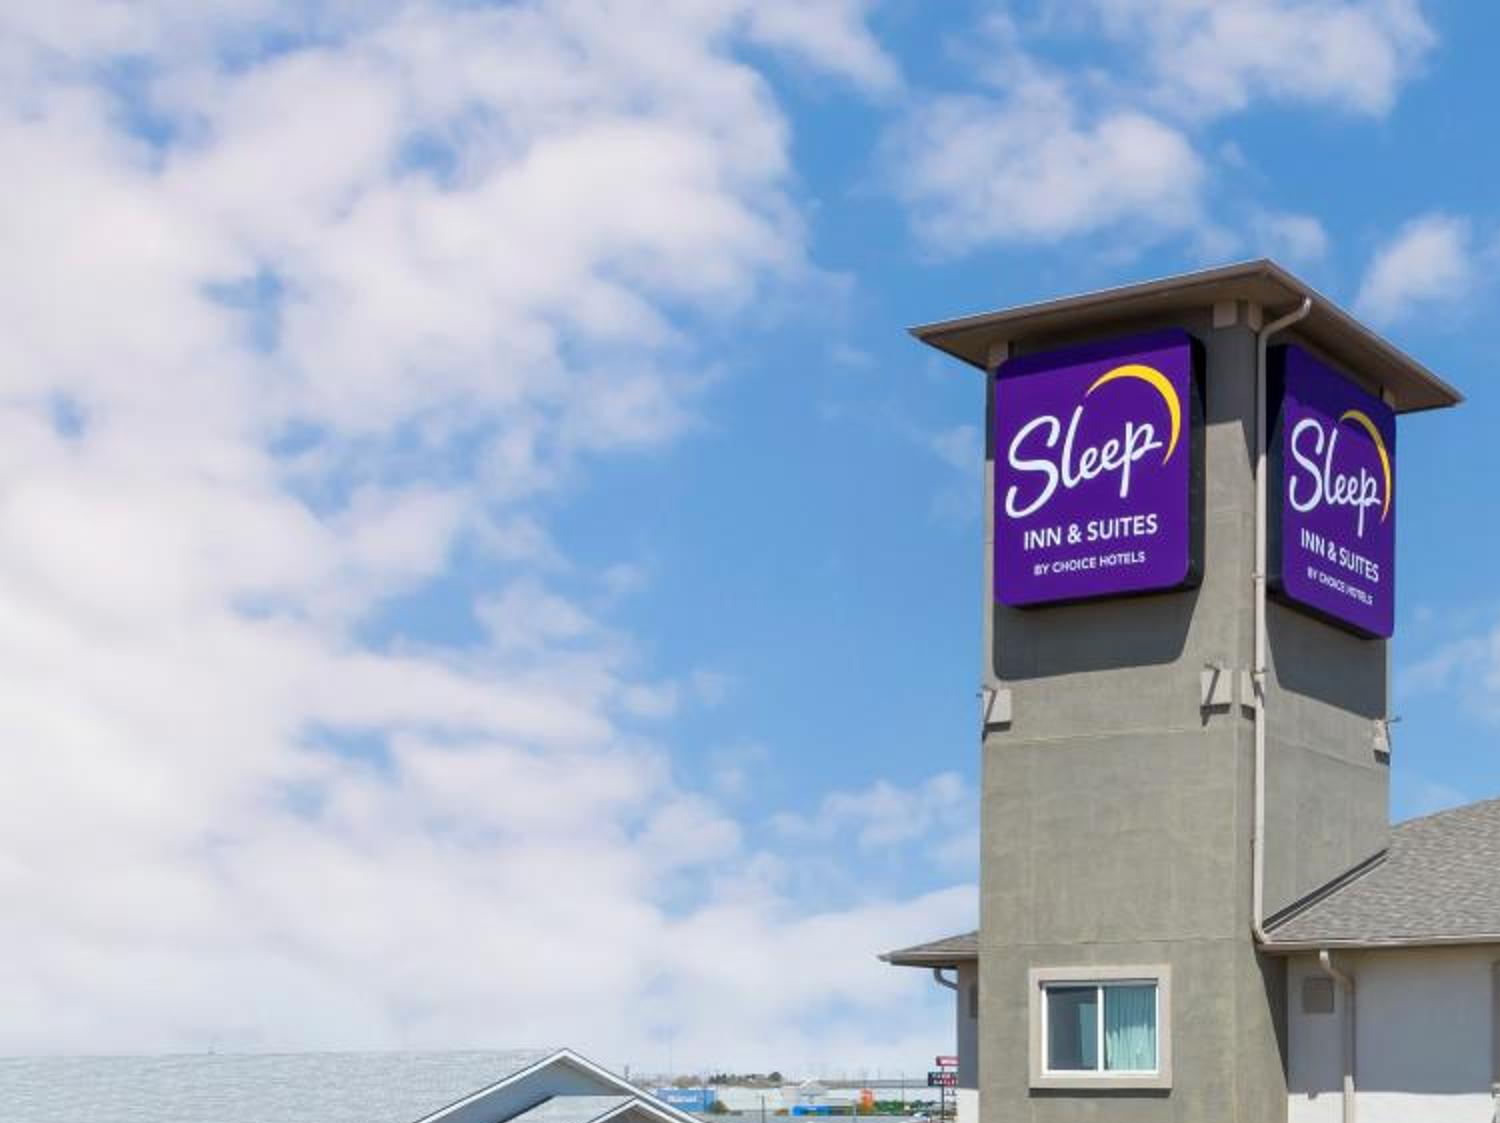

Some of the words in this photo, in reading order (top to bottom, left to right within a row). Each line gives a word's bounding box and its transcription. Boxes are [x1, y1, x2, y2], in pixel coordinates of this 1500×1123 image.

[1005, 405, 1163, 518] Sleep
[1289, 419, 1381, 538] Sleep
[1024, 527, 1061, 551] INN
[1067, 522, 1082, 543] &
[1086, 514, 1158, 541] SUITES
[1300, 528, 1325, 556] INN
[1327, 541, 1337, 563] &
[1339, 549, 1379, 583] SUITES
[1034, 563, 1049, 576] BY
[1052, 556, 1097, 574] CHOICE
[1100, 551, 1146, 567] HOTELS
[1307, 566, 1317, 579] BY
[1319, 571, 1345, 593] CHOICE
[1347, 583, 1373, 605] HOTELS
